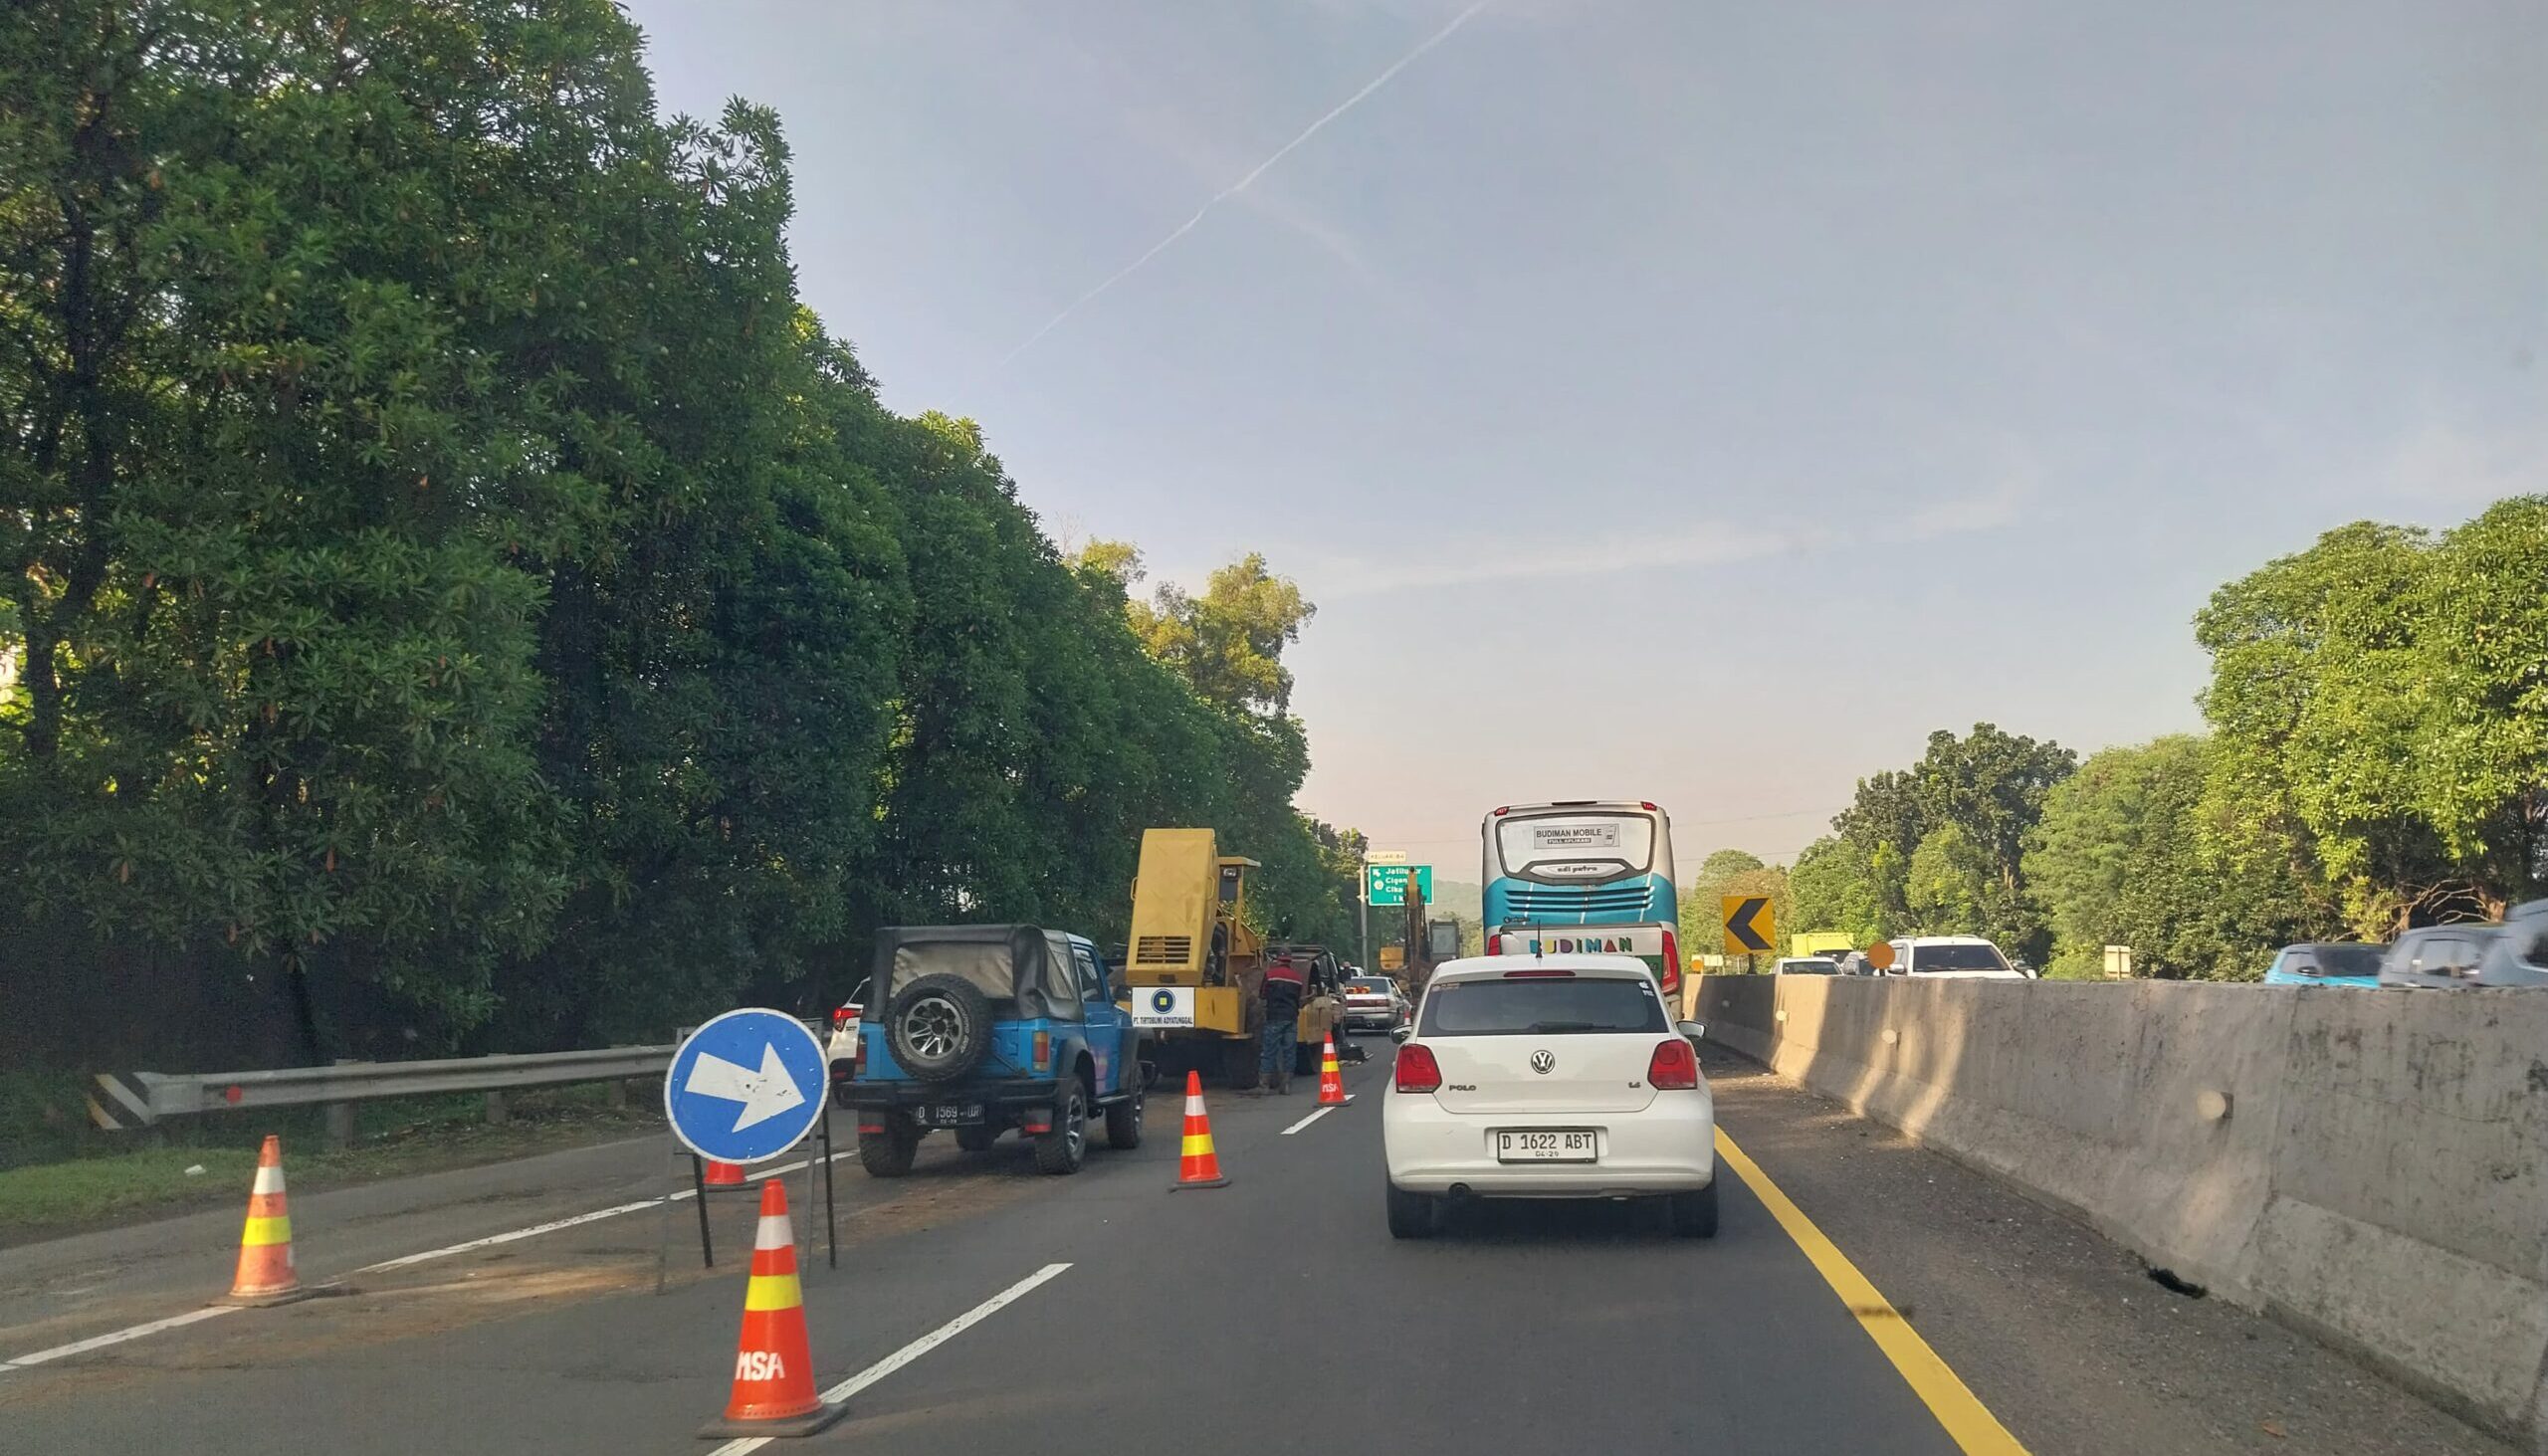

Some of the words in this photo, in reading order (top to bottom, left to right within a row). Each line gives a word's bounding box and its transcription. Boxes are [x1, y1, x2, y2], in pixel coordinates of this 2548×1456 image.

[1536, 829, 1571, 838] BUDIMAN
[1573, 828, 1601, 837] MOBILE
[1529, 937, 1632, 954] BUDIMAN
[918, 1106, 926, 1119] D
[936, 1106, 957, 1119] 1569
[1502, 1135, 1512, 1149] D
[1521, 1135, 1557, 1149] 1622
[1565, 1135, 1592, 1149] ABT
